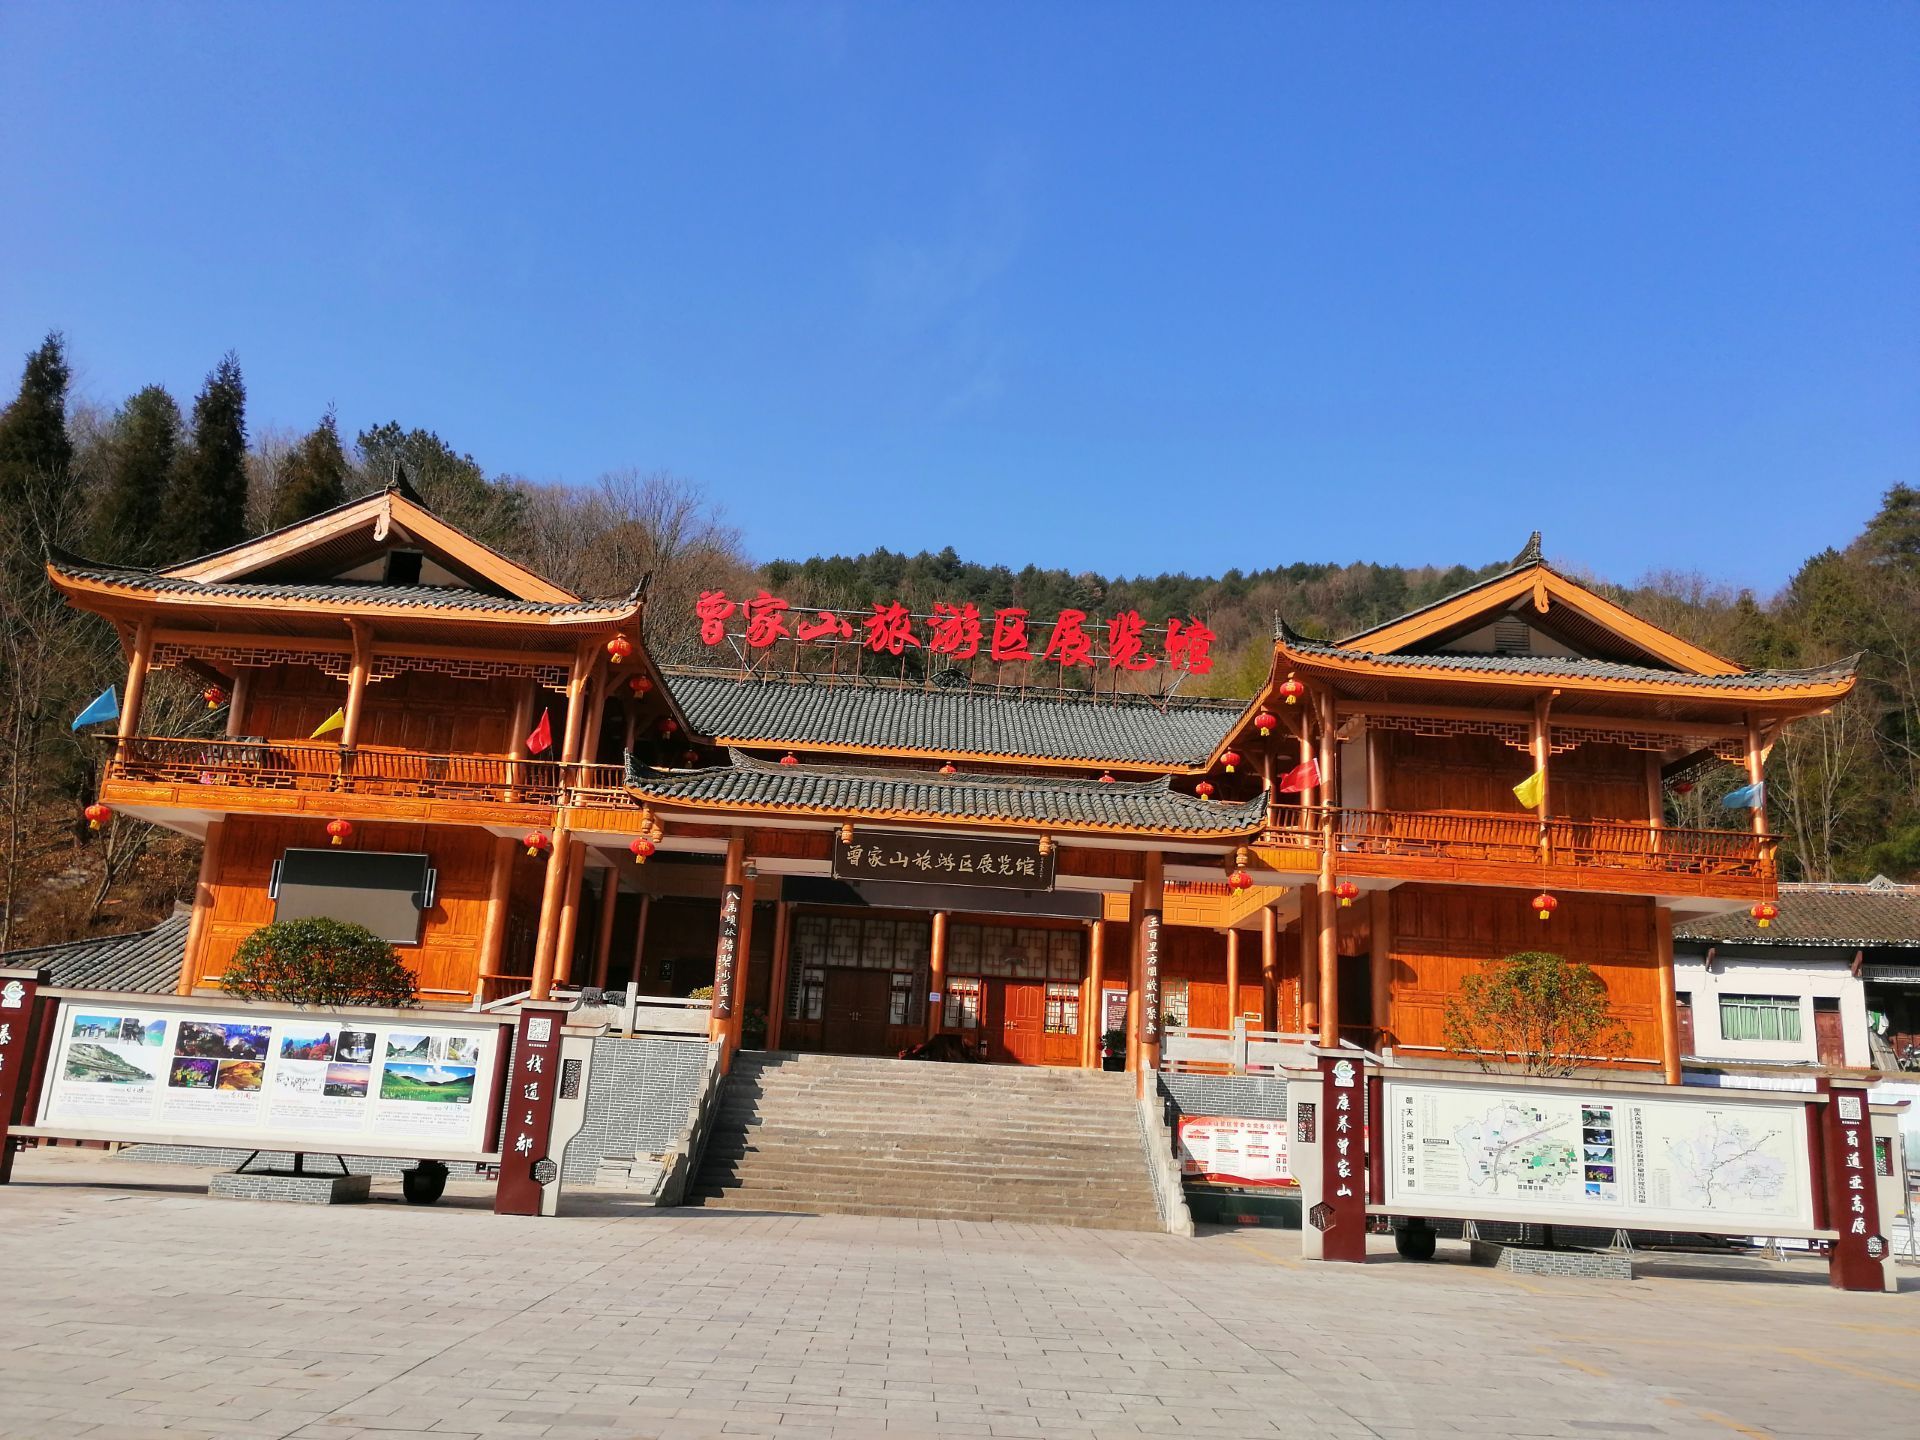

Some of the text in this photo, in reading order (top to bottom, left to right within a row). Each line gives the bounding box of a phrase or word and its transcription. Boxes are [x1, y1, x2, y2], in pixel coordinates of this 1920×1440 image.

[696, 590, 1217, 675] 曾家山旅游区展览馆
[847, 845, 1036, 876] 曾家山旅游区展览馆
[514, 1054, 544, 1157] 栈道之都
[1845, 1130, 1867, 1234] 蜀道亚高原
